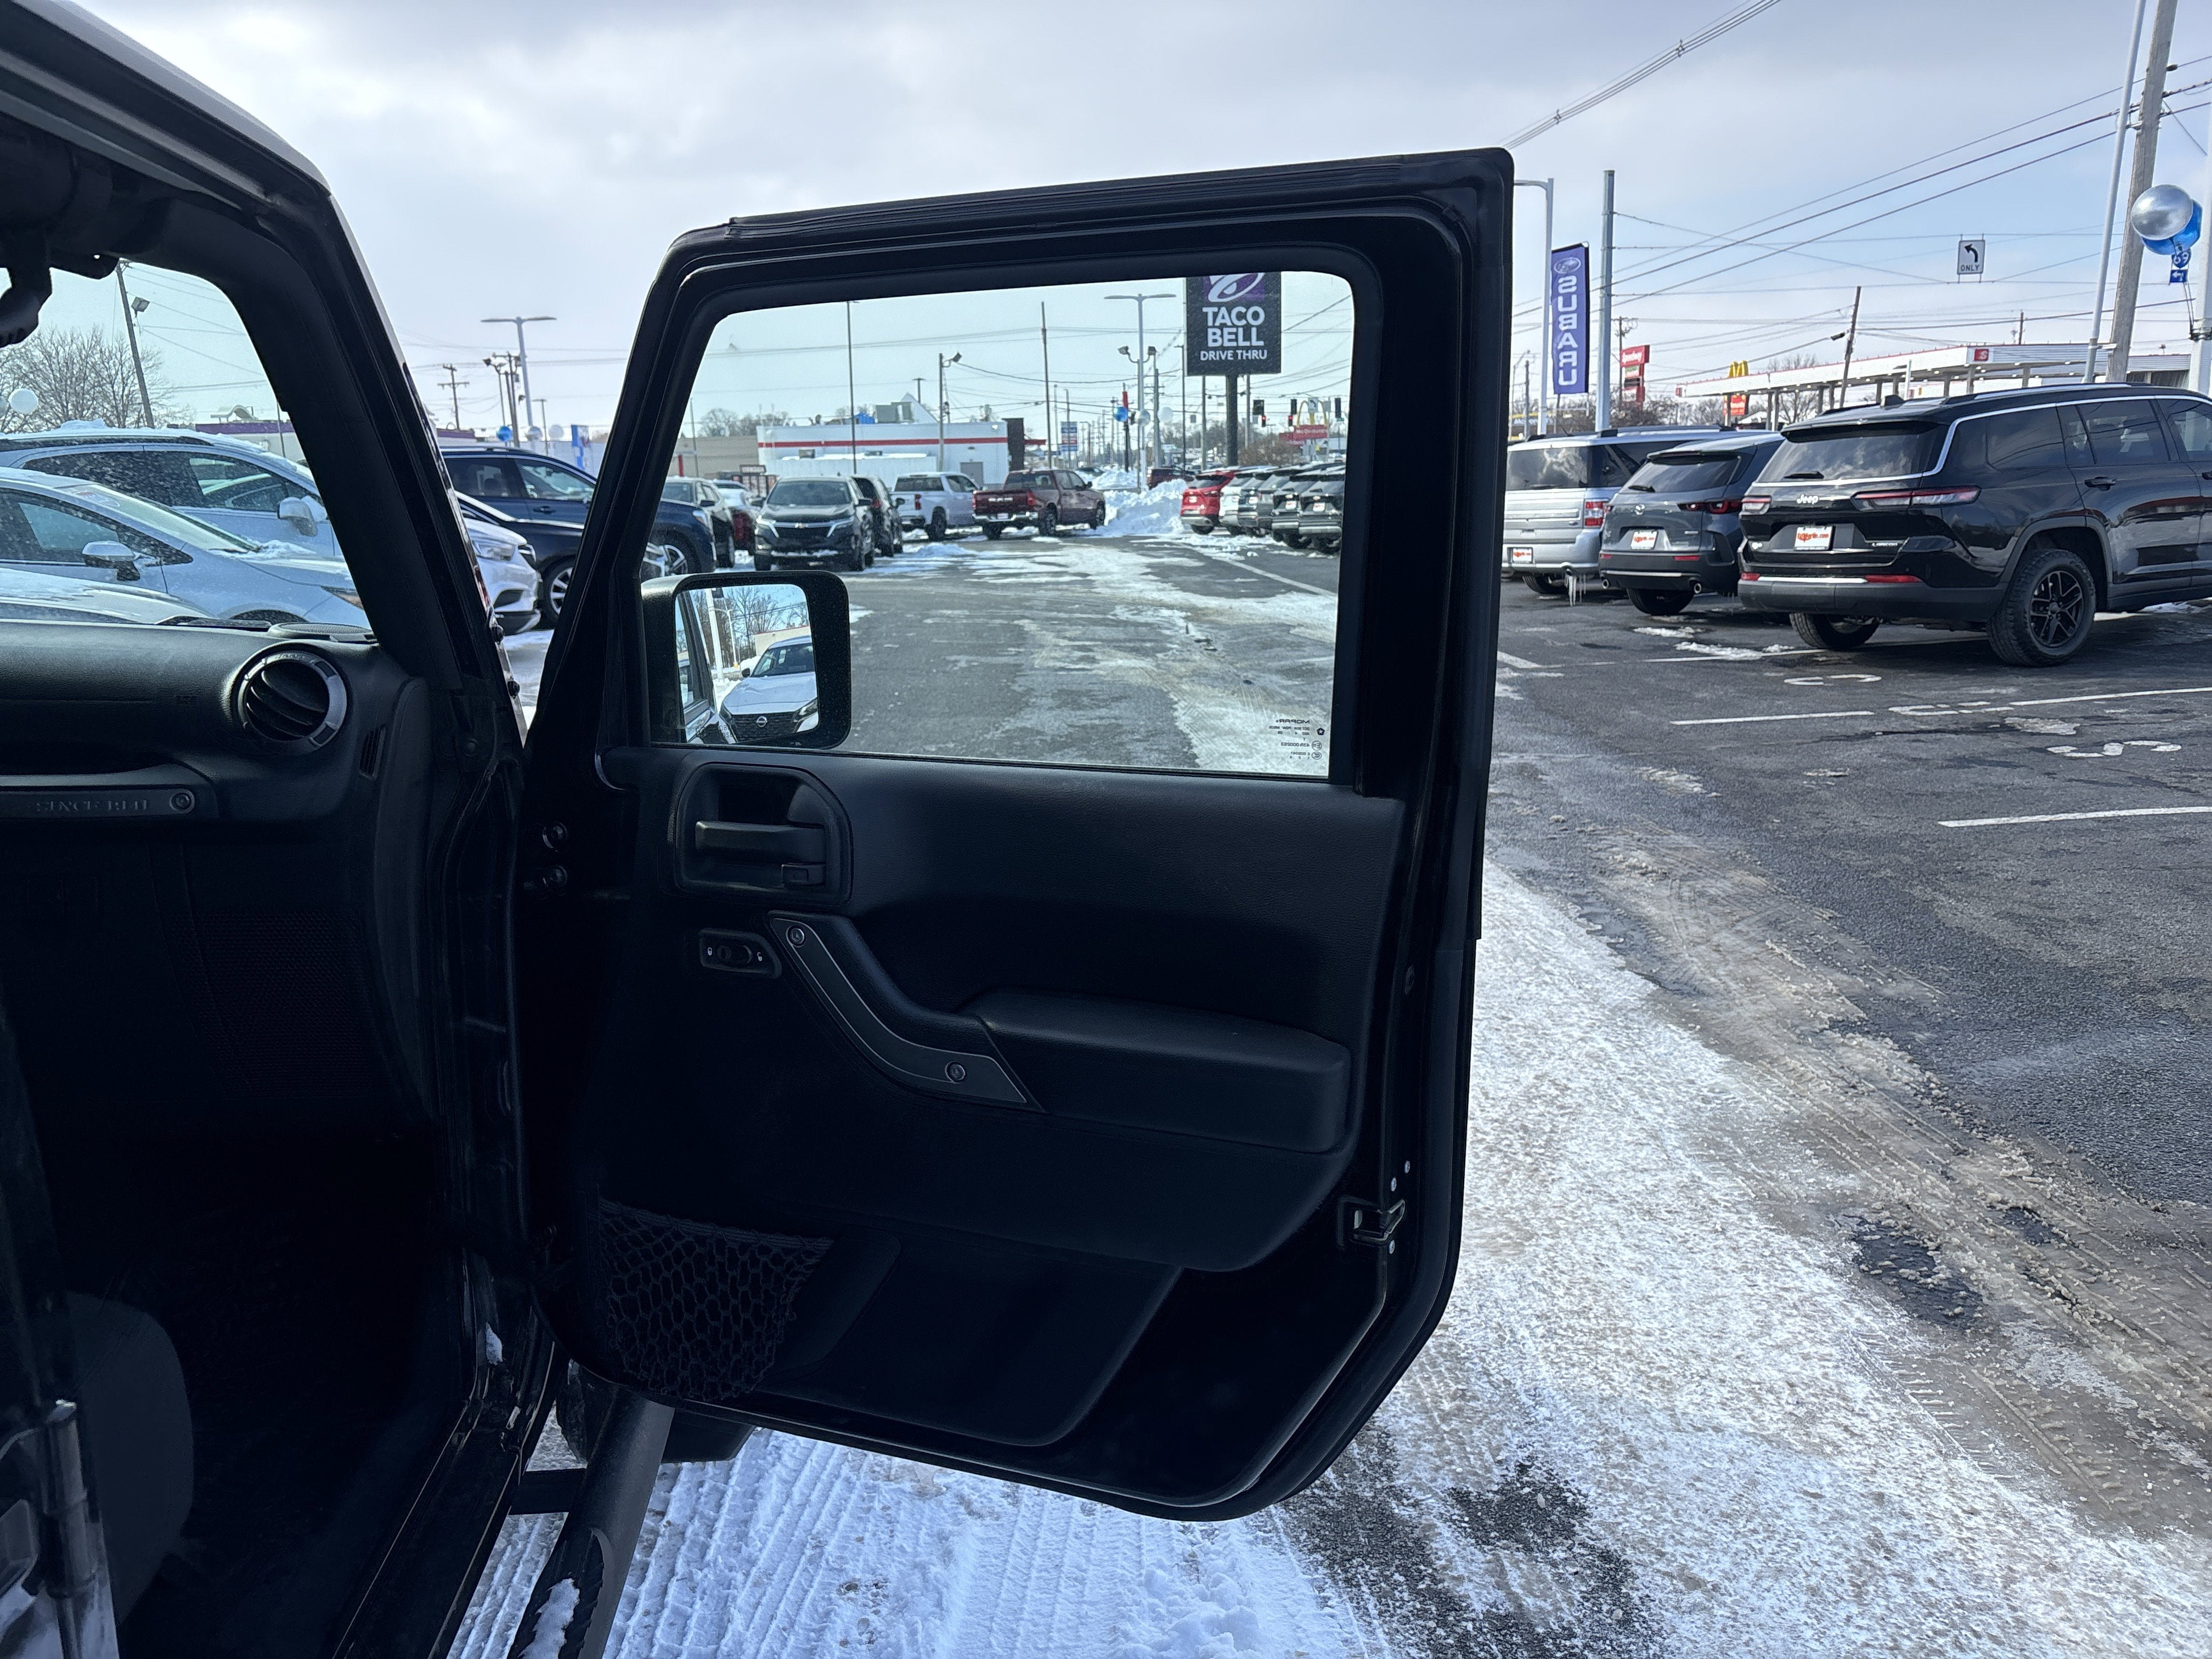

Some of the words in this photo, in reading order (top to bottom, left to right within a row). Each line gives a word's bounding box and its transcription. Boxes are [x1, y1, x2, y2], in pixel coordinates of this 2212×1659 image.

[2173, 251, 2189, 264] 69
[1202, 306, 1265, 326] TACO
[1207, 326, 1265, 347] BELL
[1200, 350, 1234, 361] DRIVE
[1237, 349, 1267, 360] THRU
[1797, 494, 1819, 505] Jeep
